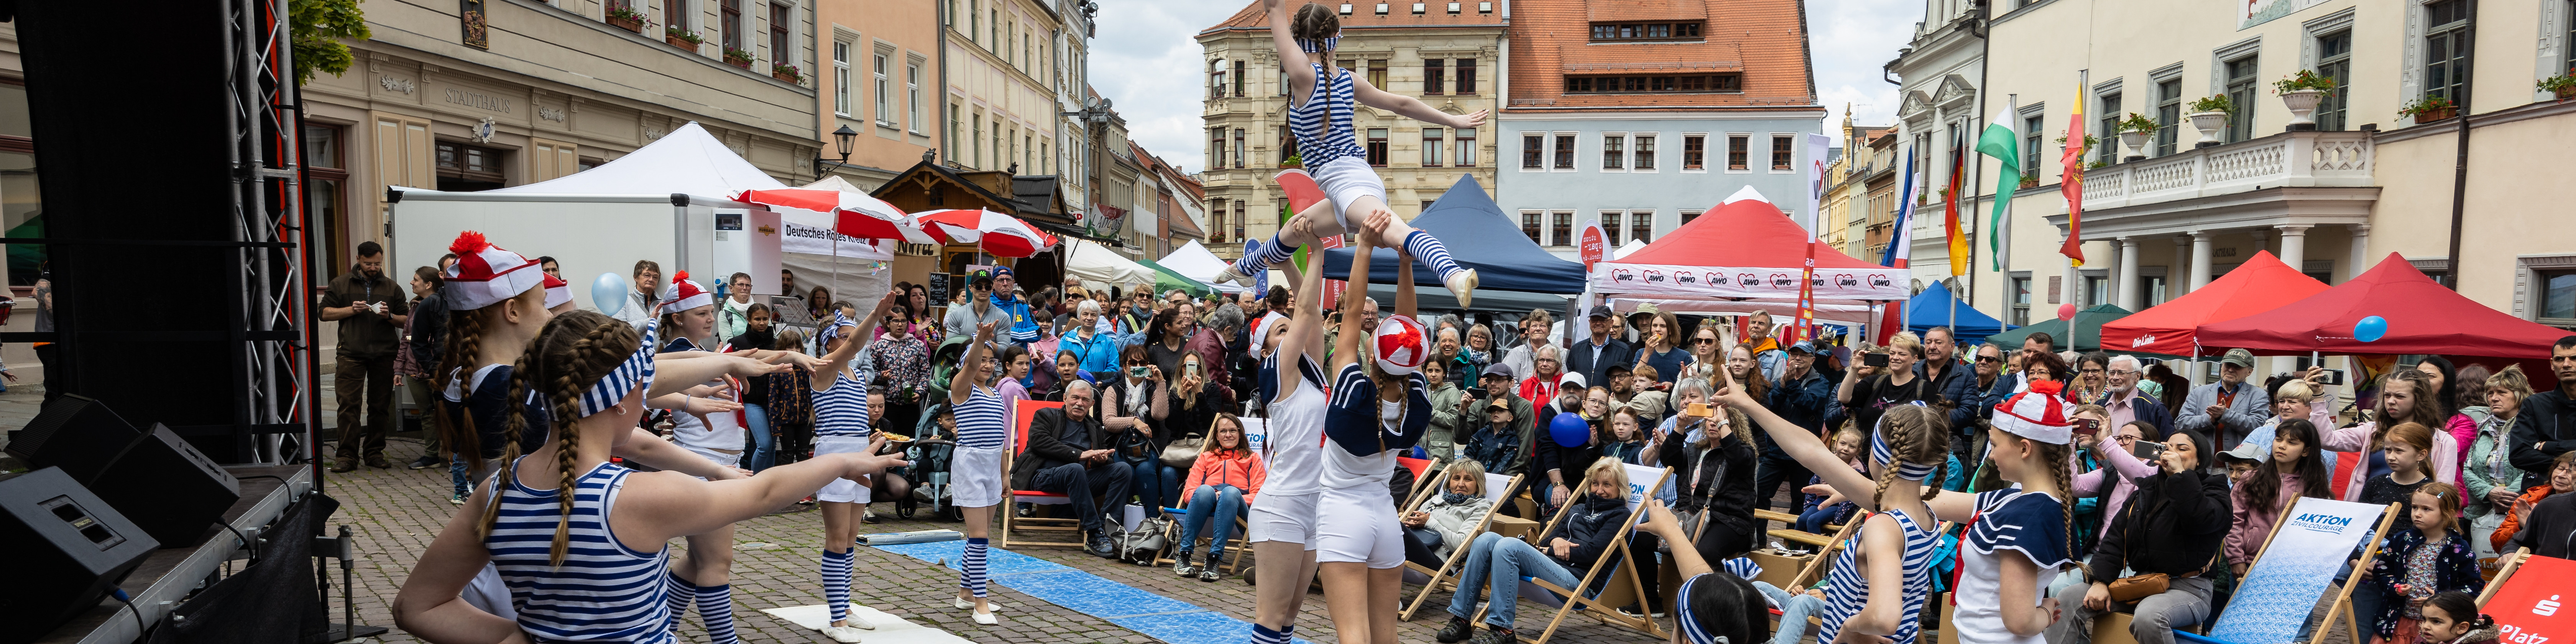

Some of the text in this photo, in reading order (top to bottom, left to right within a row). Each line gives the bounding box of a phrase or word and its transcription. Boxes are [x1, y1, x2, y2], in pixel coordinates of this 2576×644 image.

[445, 87, 511, 113] STADTHAUS
[786, 224, 825, 239] Deutsches
[2132, 333, 2155, 348] Die Linke
[2291, 521, 2345, 532] ZIVILCOURAGE
[2500, 624, 2549, 644] Platz
